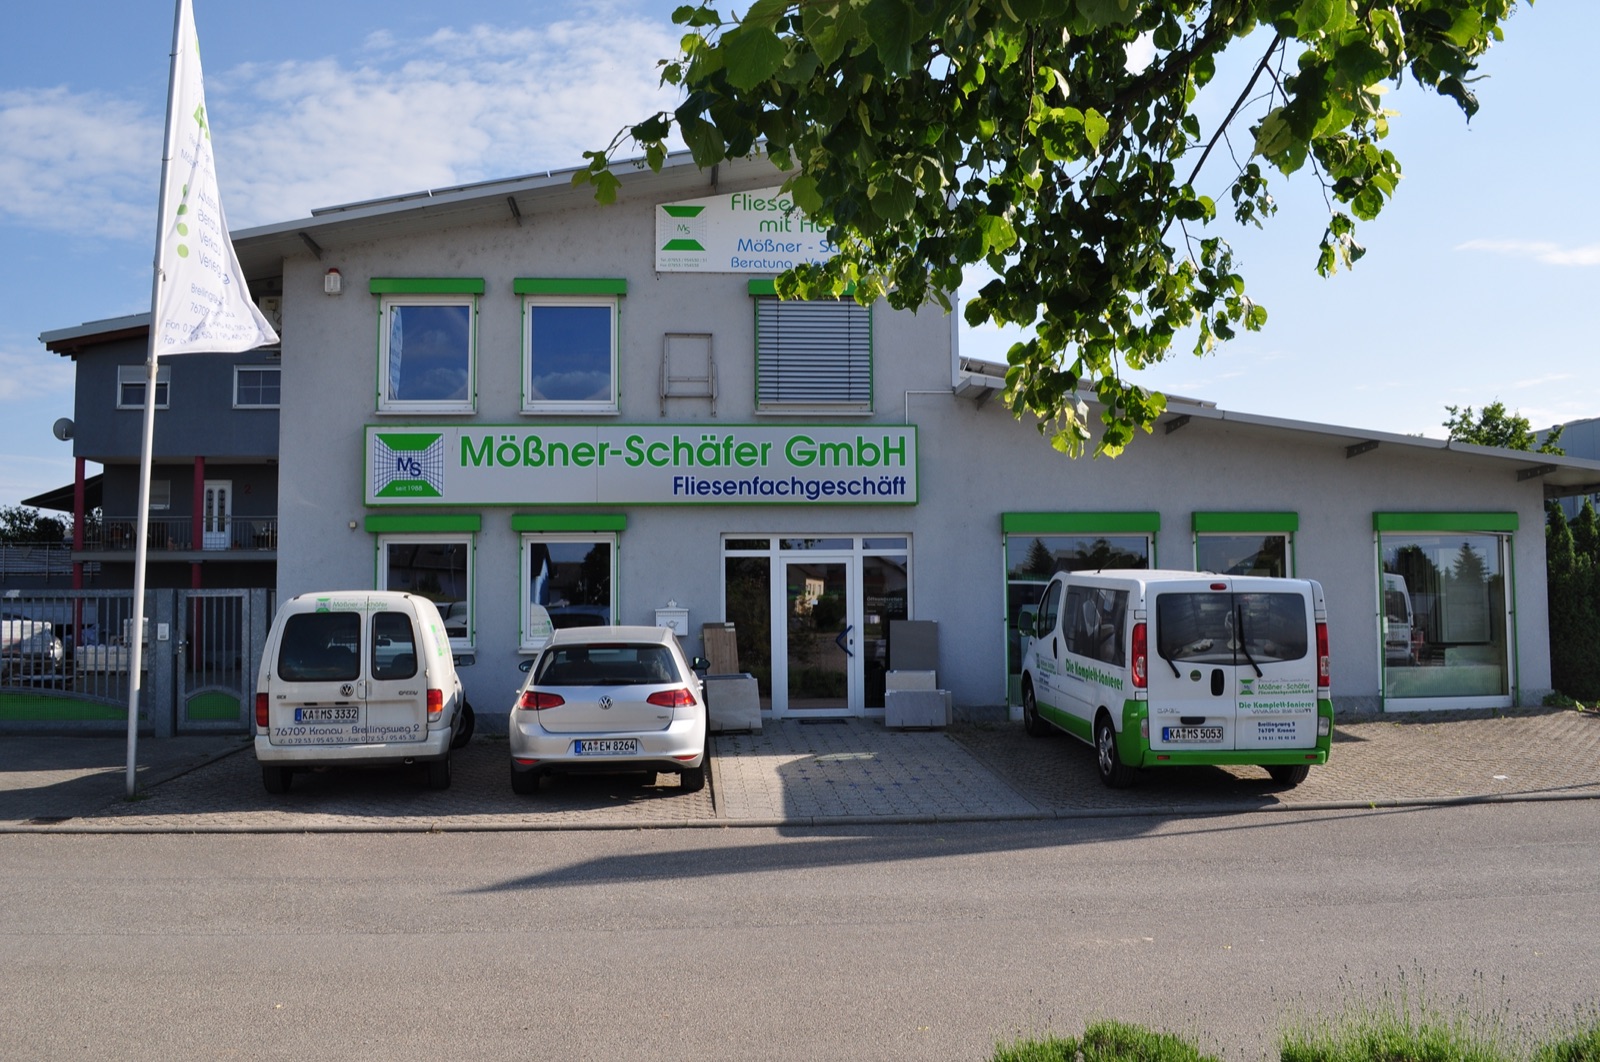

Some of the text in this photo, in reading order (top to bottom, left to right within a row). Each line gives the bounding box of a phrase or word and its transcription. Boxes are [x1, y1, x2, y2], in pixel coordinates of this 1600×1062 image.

[731, 193, 791, 211] Fliese
[760, 216, 791, 233] mit
[737, 238, 802, 253] Mößner
[461, 434, 906, 467] Mößner-Schäfer GmbH
[397, 457, 422, 477] MS
[673, 476, 907, 500] Fliesenfachgeschäft
[302, 708, 358, 720] KA MS 3332
[275, 727, 307, 737] 76709
[309, 726, 343, 736] Kronau
[352, 724, 411, 736] Breilingsweg
[413, 723, 420, 732] 2
[1170, 728, 1222, 739] KA MS 5053
[581, 740, 635, 752] KA EW 8264
